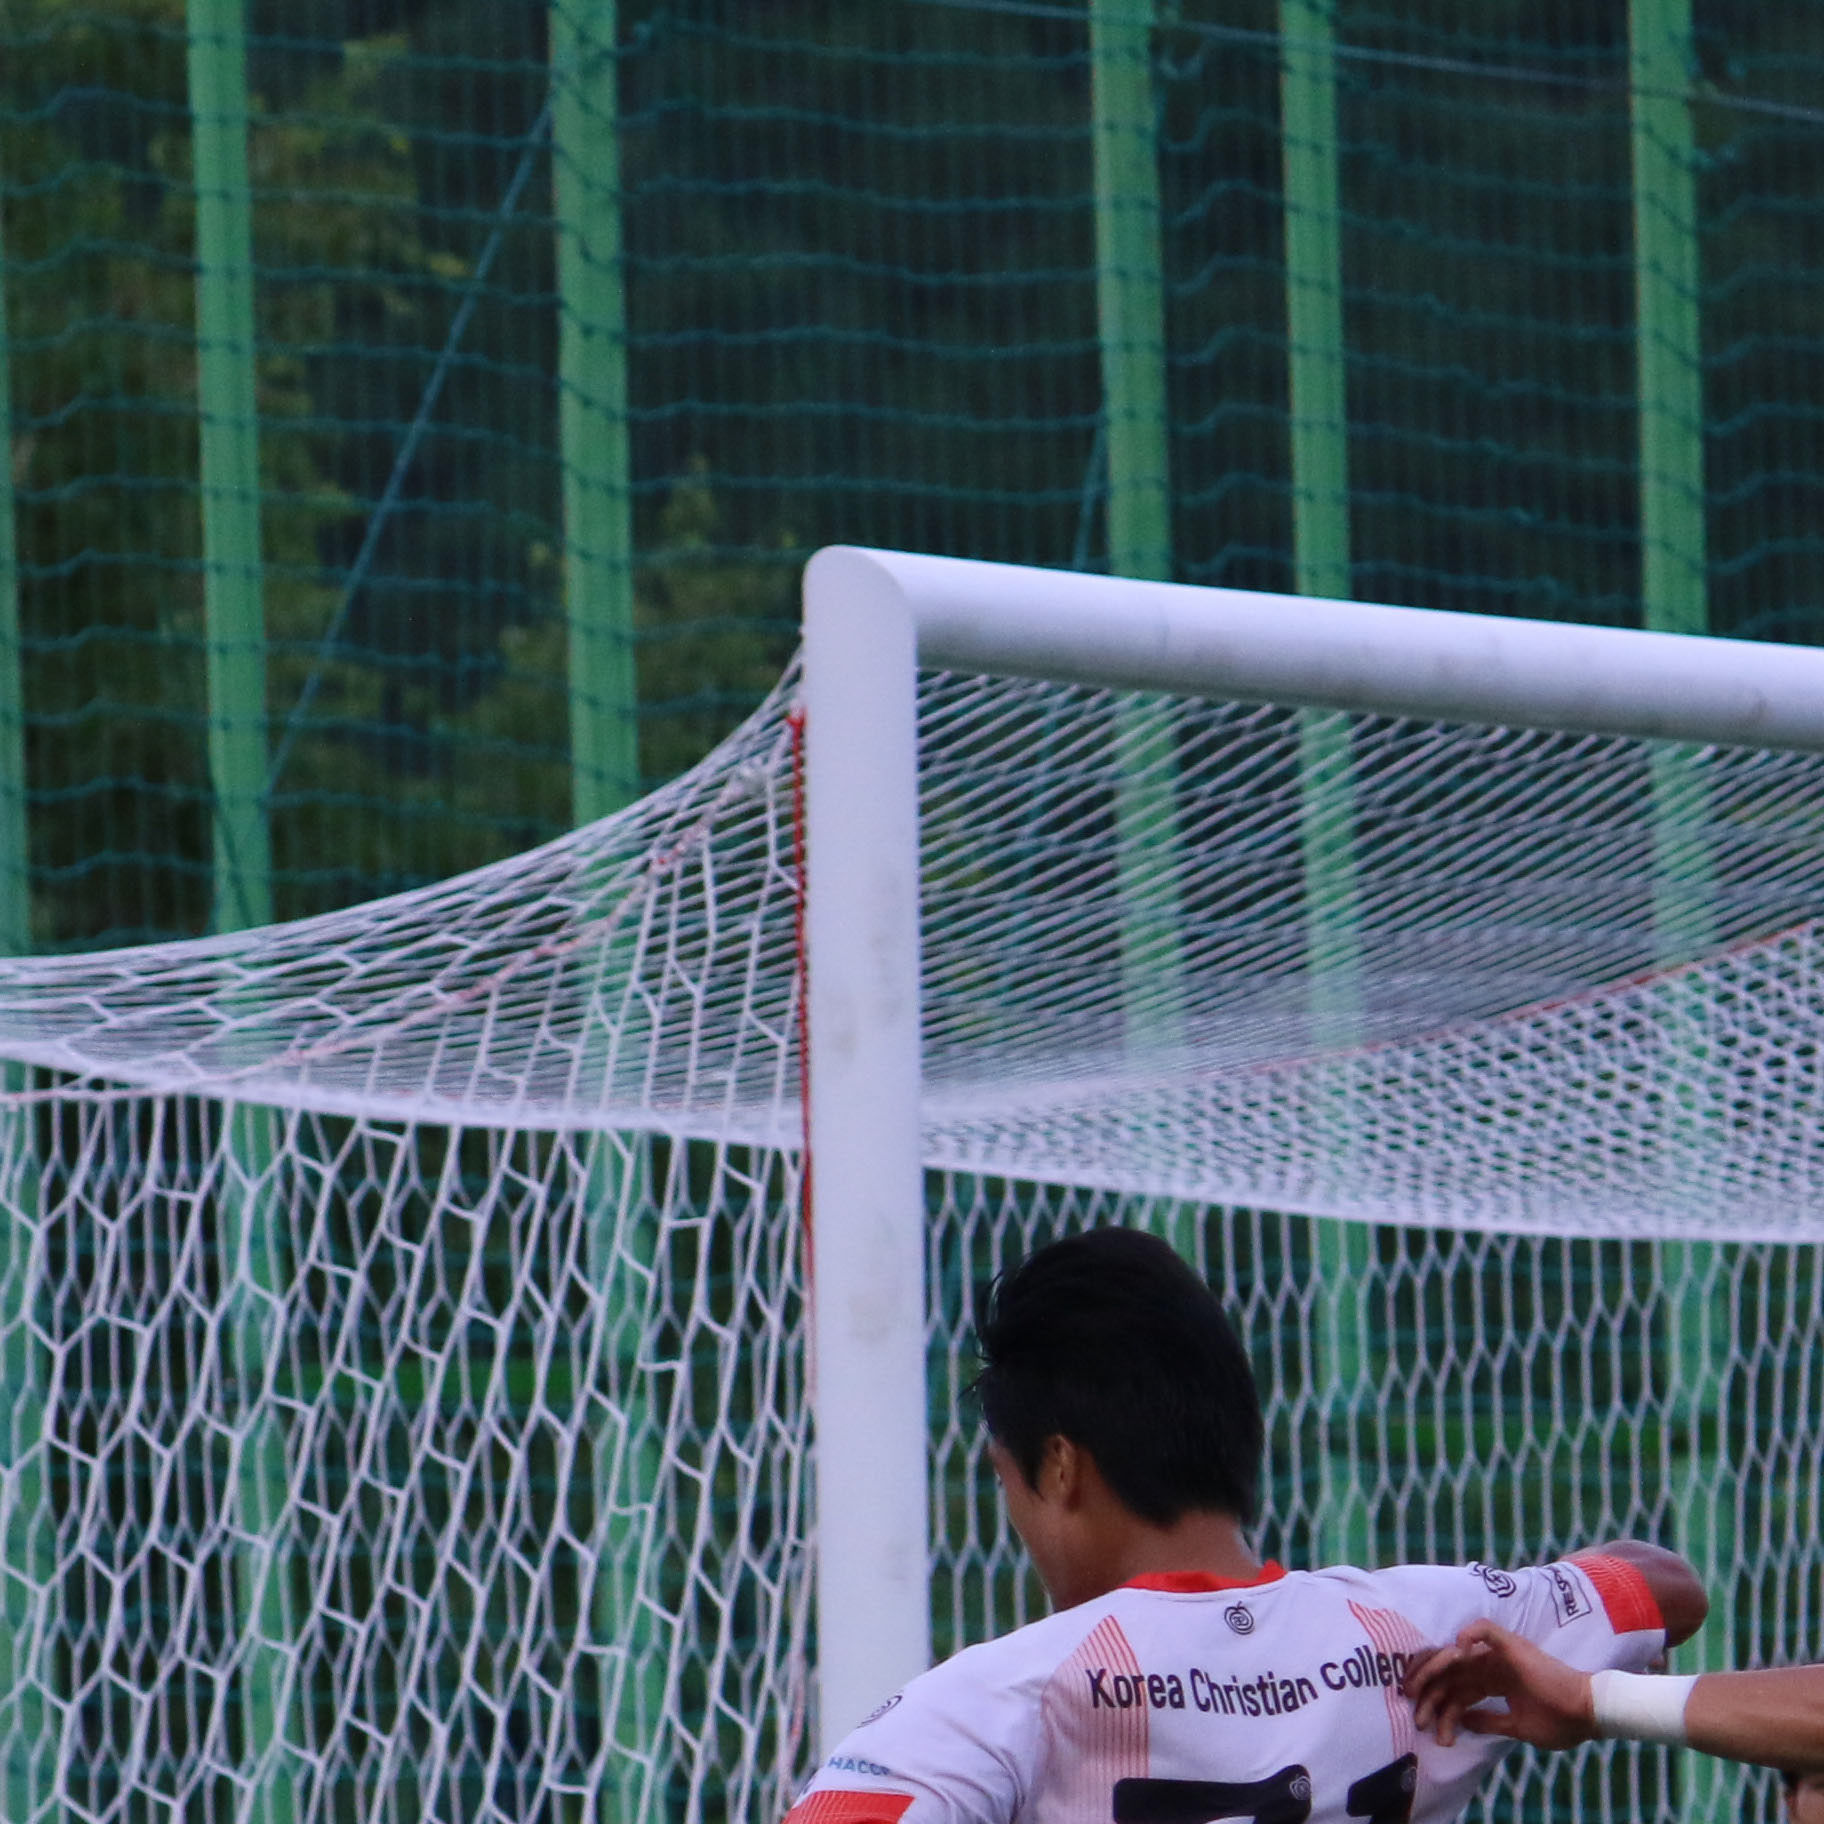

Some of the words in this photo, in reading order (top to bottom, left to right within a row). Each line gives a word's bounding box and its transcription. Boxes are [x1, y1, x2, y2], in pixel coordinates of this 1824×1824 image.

[1085, 1667, 1187, 1710] Korea
[1189, 1667, 1319, 1718] Christian
[1319, 1645, 1414, 1695] colleg
